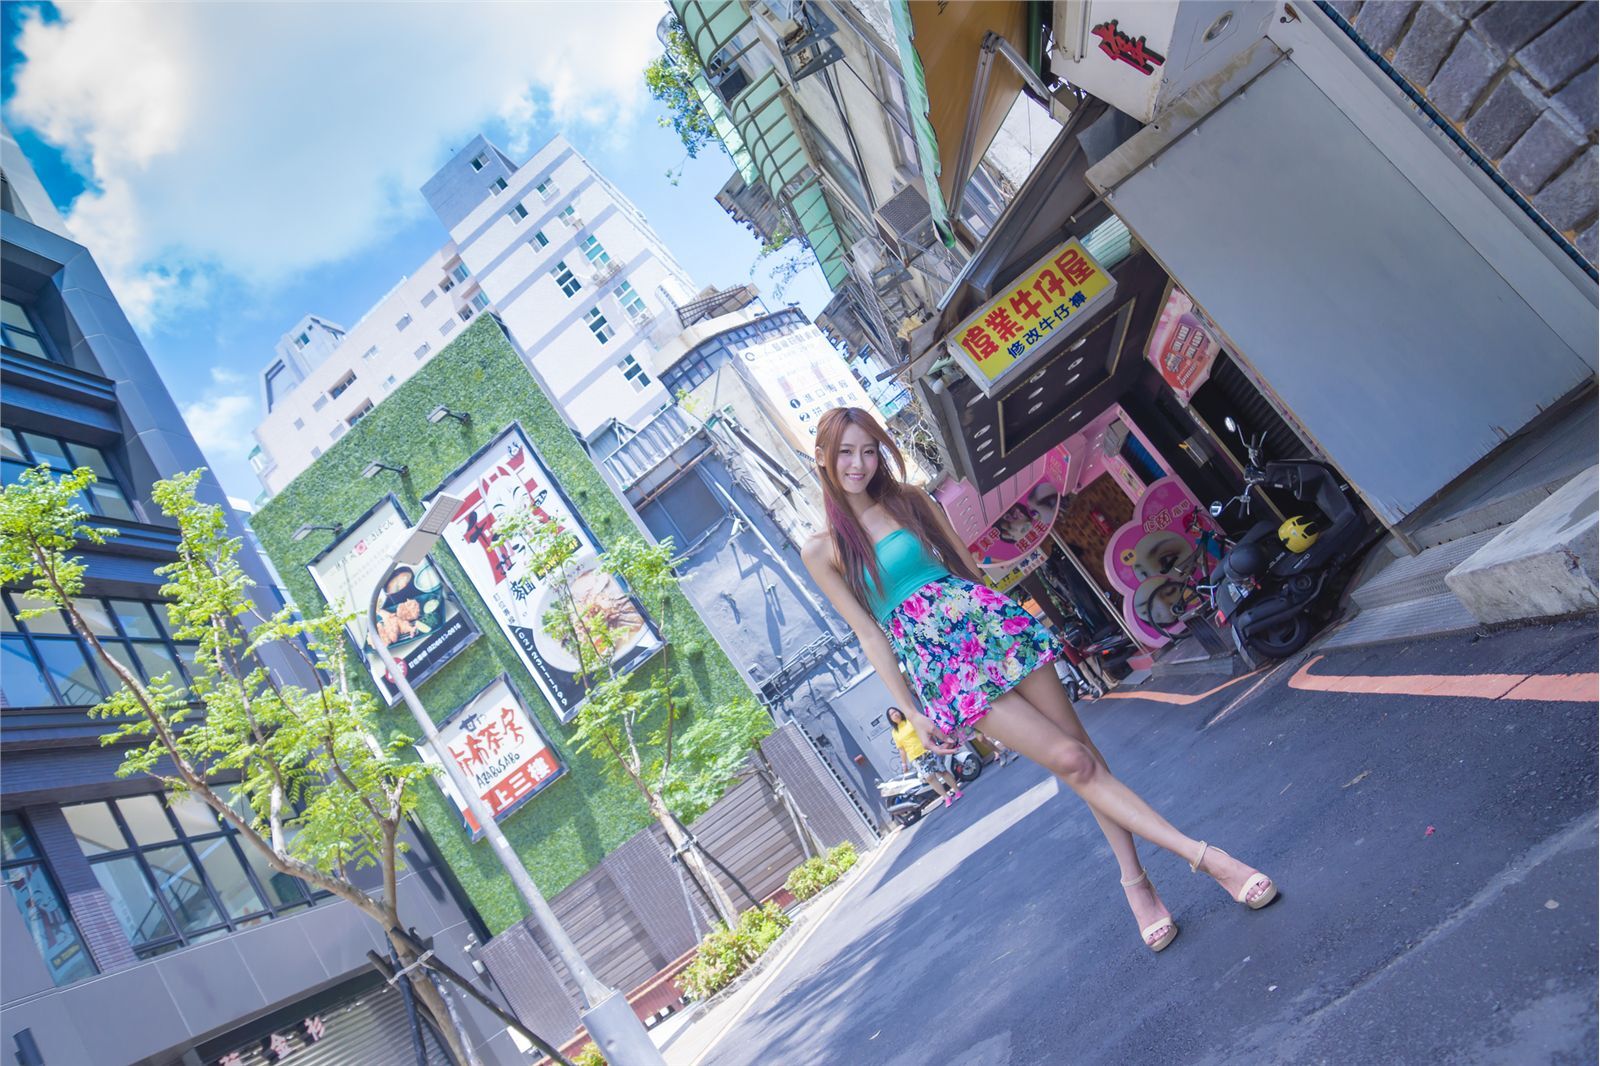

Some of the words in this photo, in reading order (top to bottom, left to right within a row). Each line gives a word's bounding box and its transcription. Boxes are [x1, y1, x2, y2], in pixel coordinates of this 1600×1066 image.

[962, 249, 1095, 362] 偉業牛仔屋
[1007, 290, 1087, 358] 修改牛仔褲
